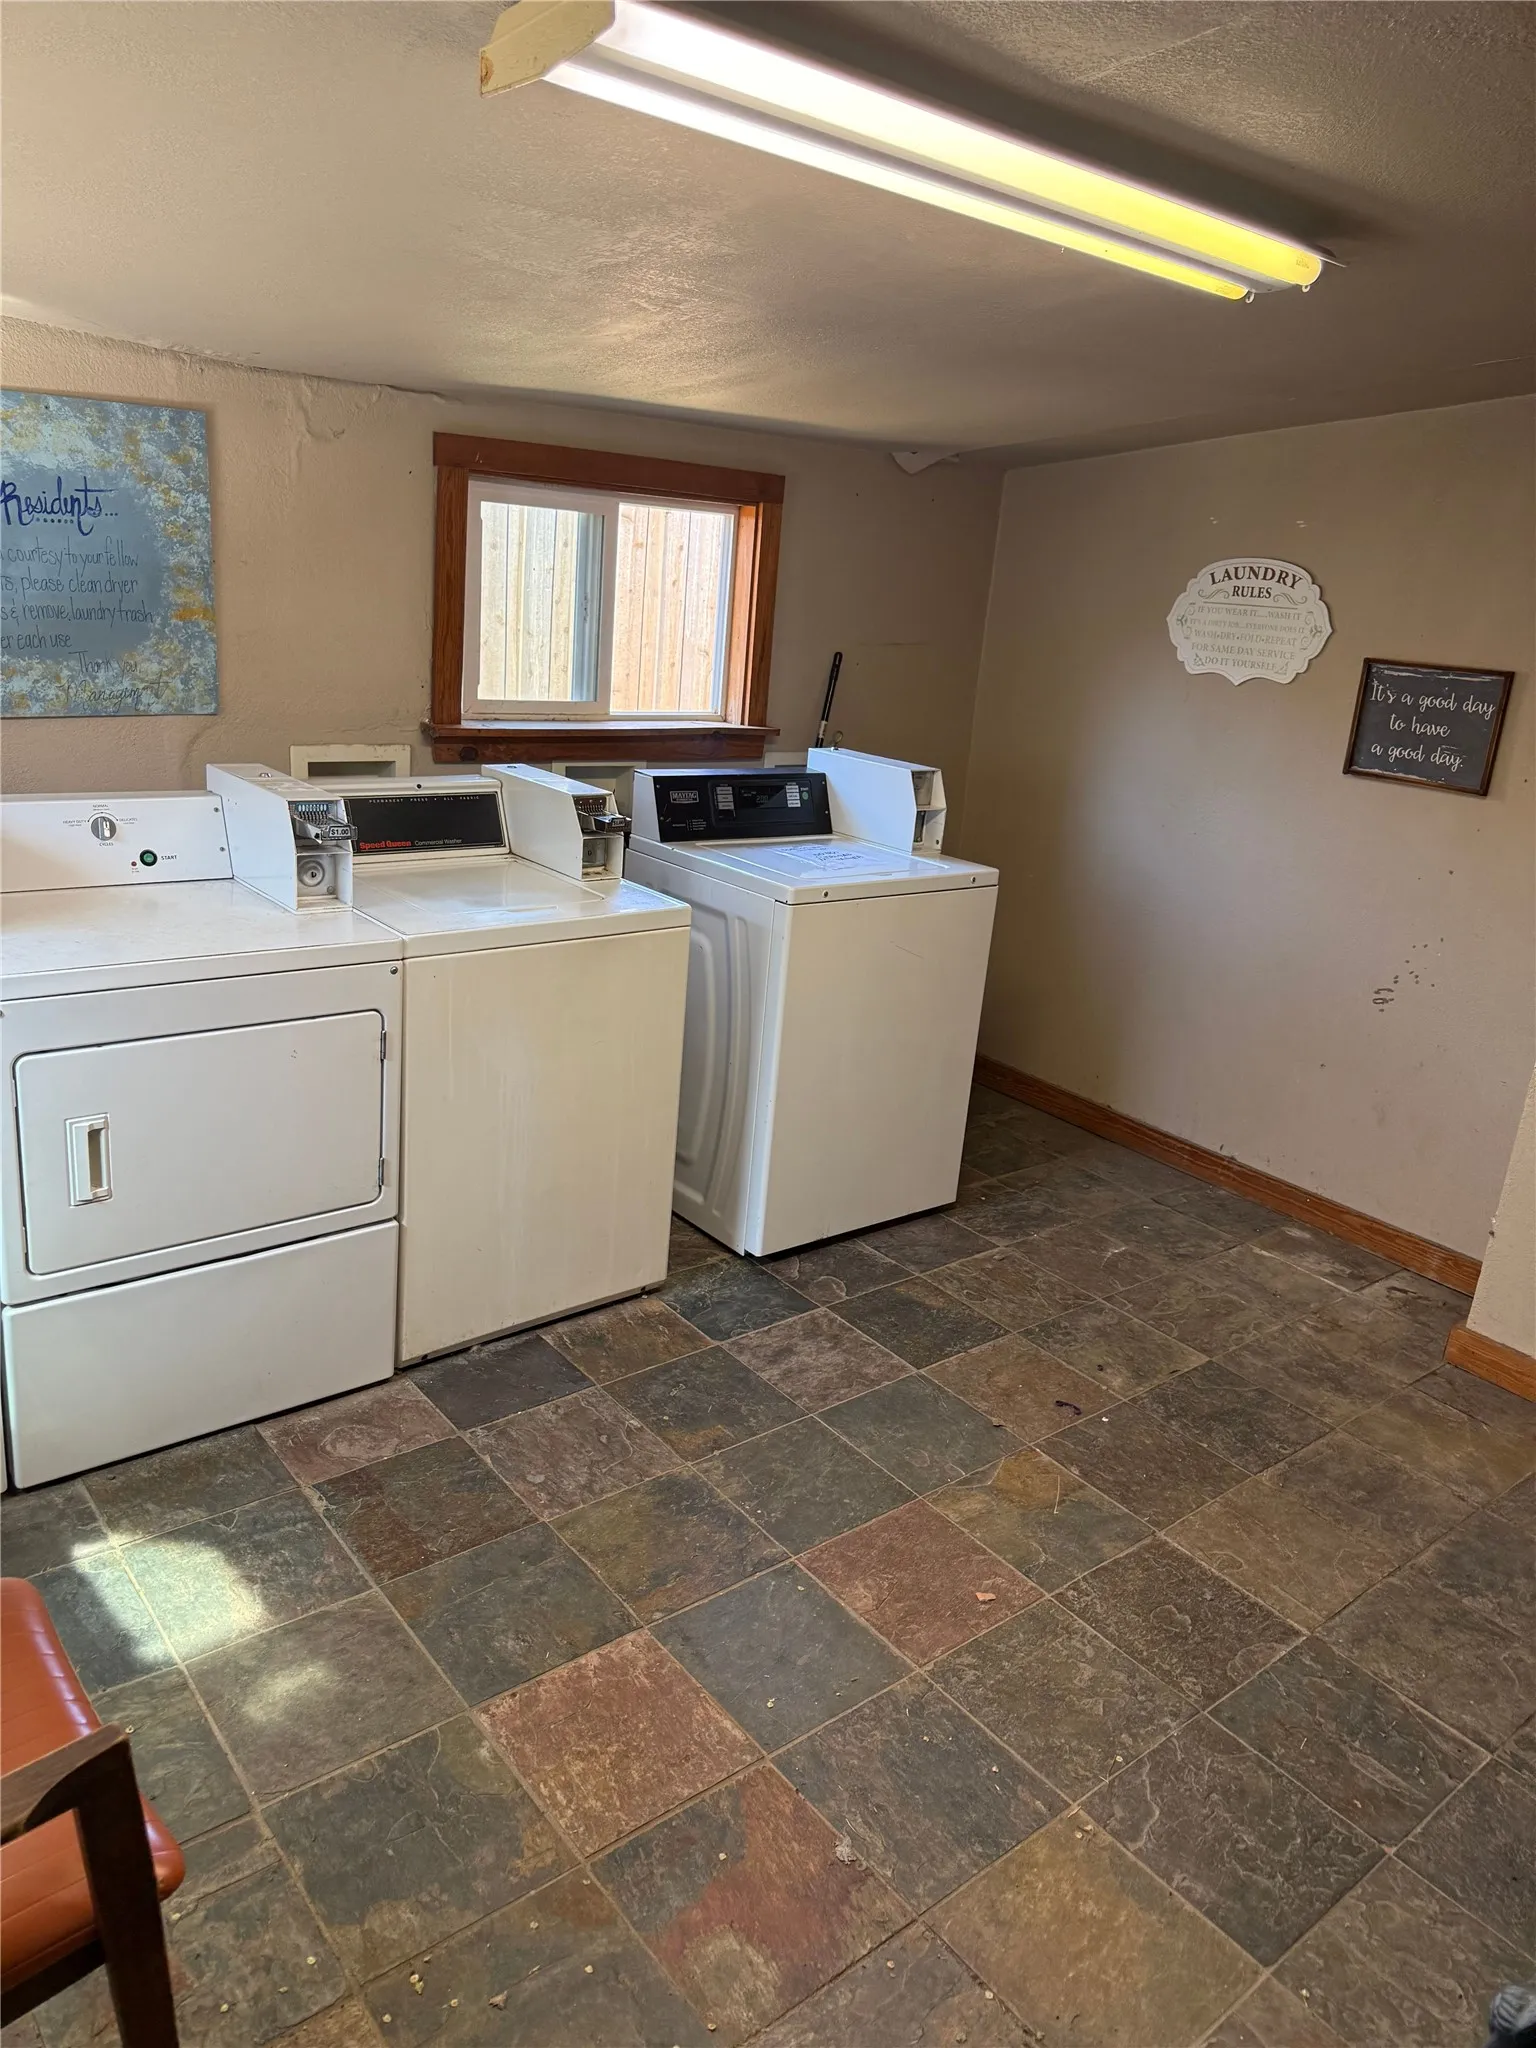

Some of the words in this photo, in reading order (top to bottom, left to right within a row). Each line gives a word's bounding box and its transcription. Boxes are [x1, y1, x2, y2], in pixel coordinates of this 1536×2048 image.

[7, 536, 63, 577] courtesy
[65, 535, 78, 565] to
[79, 553, 104, 578] your
[104, 535, 139, 567] fellow
[20, 566, 64, 600] please
[69, 568, 103, 594] clean
[104, 570, 139, 600] dryer
[1209, 566, 1303, 590] LAUNDRY
[1231, 585, 1272, 599] RULES
[69, 596, 115, 628] laundry
[115, 599, 154, 623] trash
[1206, 606, 1223, 615] YOU
[1225, 608, 1248, 617] WEAR
[1268, 611, 1291, 620] WASH
[17, 625, 48, 650] each
[50, 633, 73, 648] use
[68, 650, 114, 674] Thank
[1191, 642, 1209, 652] FOR
[1210, 644, 1235, 655] SAME
[1237, 646, 1255, 656] DAY
[1256, 647, 1296, 660] SERVICE
[1204, 656, 1219, 665] DO
[1220, 657, 1229, 666] IT
[1232, 659, 1276, 671] YOURSELF
[1370, 680, 1397, 704] It's
[1401, 693, 1414, 706] a
[1418, 693, 1458, 712] good
[1463, 695, 1496, 721] day
[1389, 713, 1406, 731] to
[1411, 716, 1451, 738] have
[1371, 743, 1384, 756] a
[1388, 744, 1426, 762] good
[331, 828, 349, 836] $1.00
[360, 841, 386, 850] Speed
[386, 839, 412, 848] Queen
[443, 837, 462, 845] Washer
